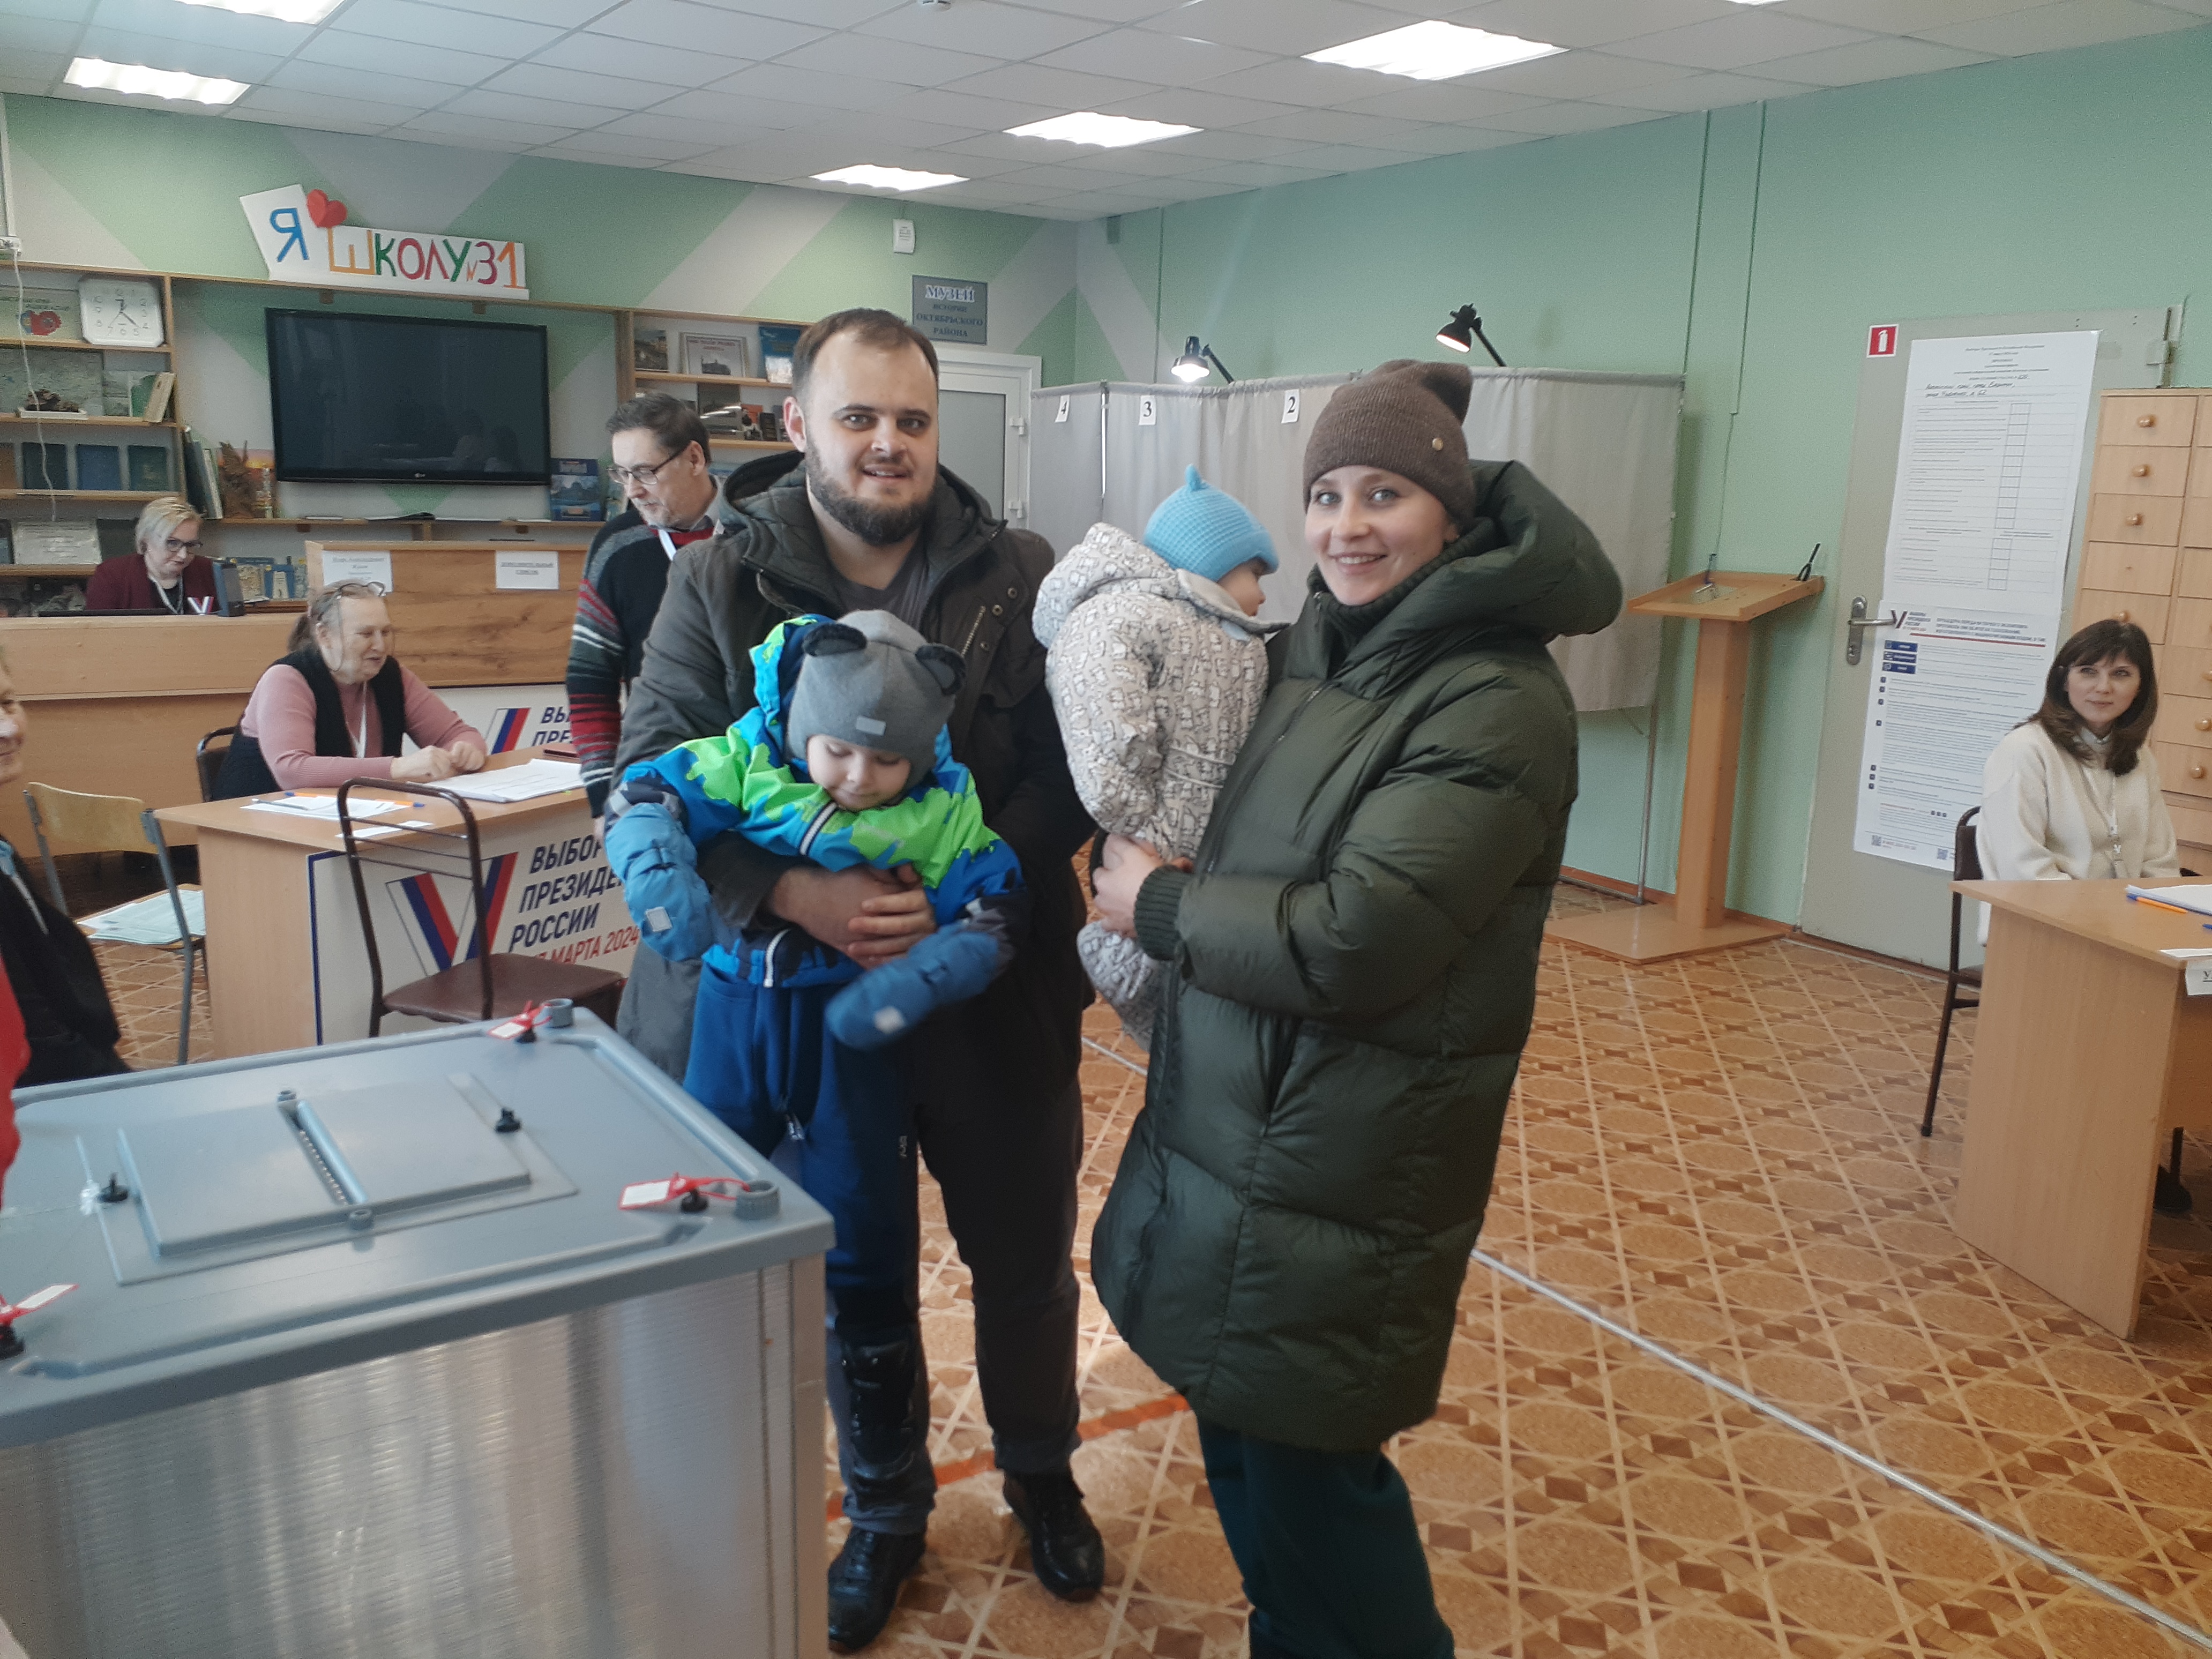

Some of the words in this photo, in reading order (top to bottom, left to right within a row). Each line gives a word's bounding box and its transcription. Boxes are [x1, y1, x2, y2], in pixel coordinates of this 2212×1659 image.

[270, 207, 310, 263] Я
[328, 227, 472, 282] ШКОЛУ
[925, 285, 975, 302] МУЗЕЙ
[916, 313, 983, 325] ОКТЯБРЬСКОГО
[933, 327, 968, 337] РАЙОНА
[1060, 401, 1068, 415] 4
[1143, 401, 1152, 417] 3
[1287, 396, 1295, 414] 2
[541, 707, 570, 723] ВЫ
[532, 730, 572, 746] ПРЕ
[529, 834, 602, 874] ВЫБО
[518, 865, 622, 913] ПРЕЗИДЕ
[509, 902, 600, 953] РОССИИ
[551, 935, 601, 965] МАРТА
[603, 925, 640, 955] 2024
